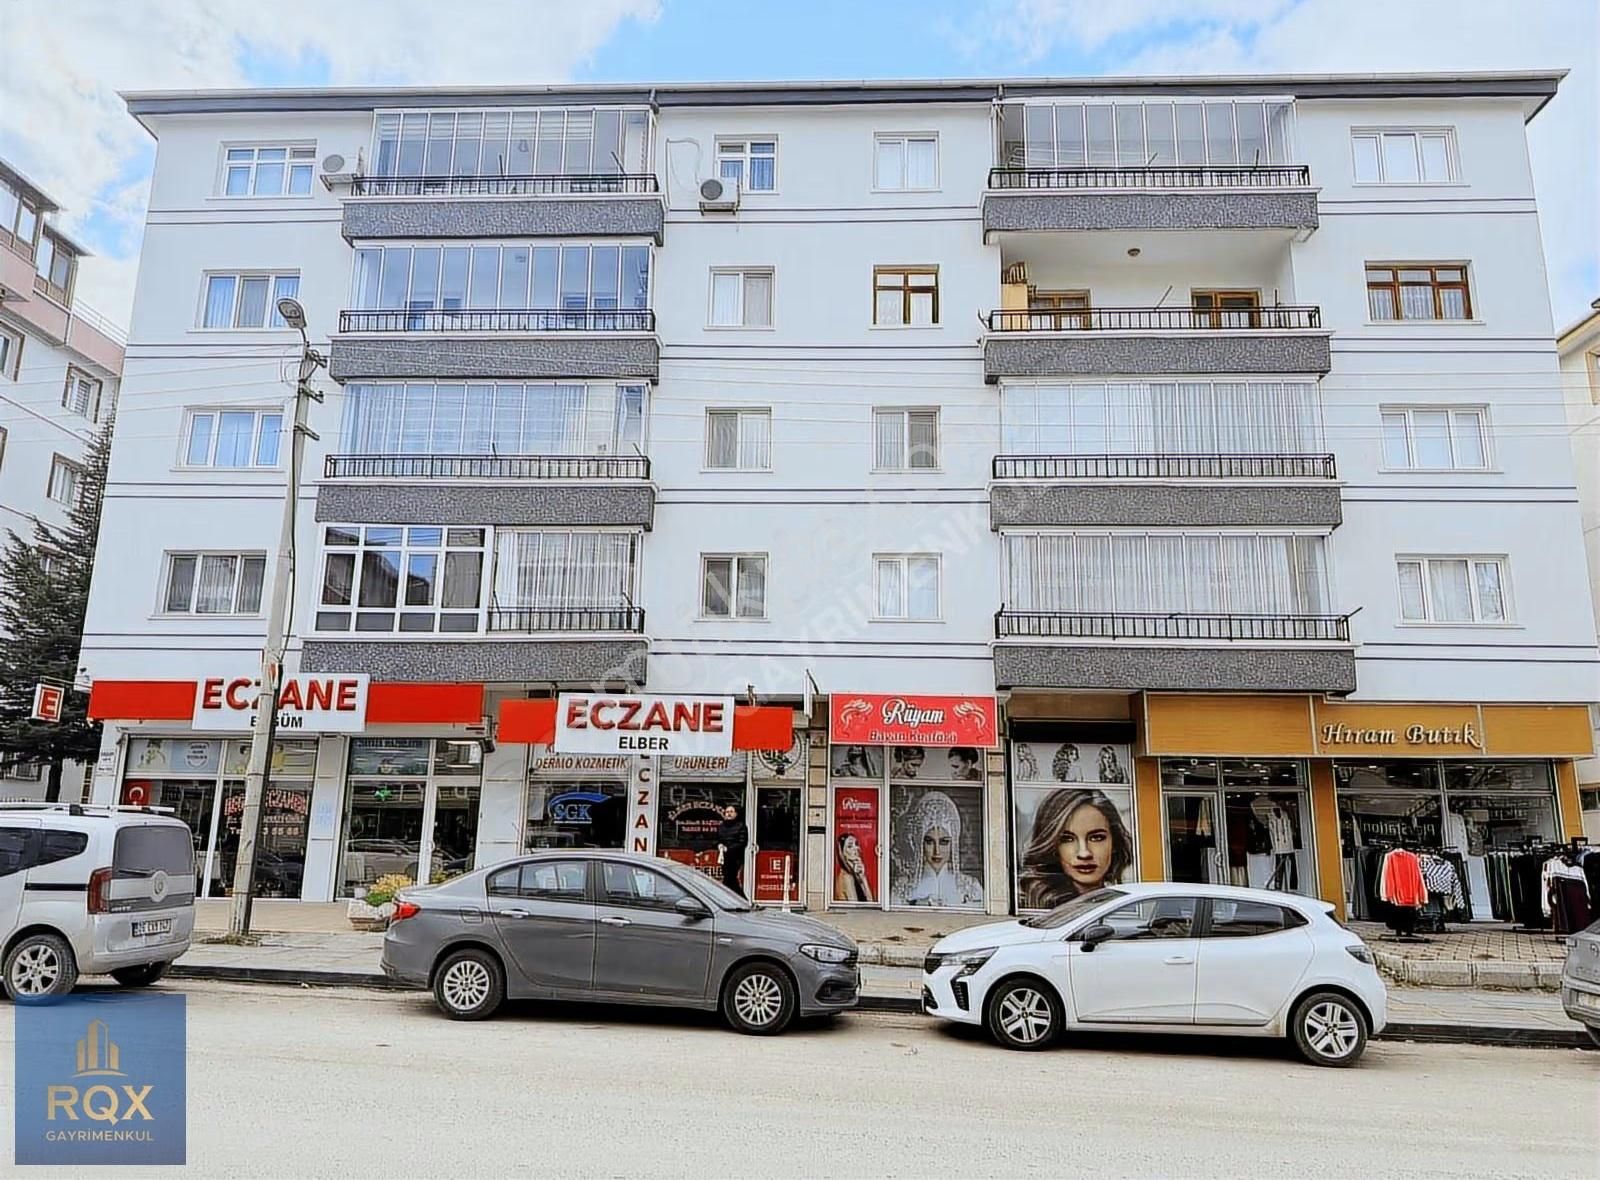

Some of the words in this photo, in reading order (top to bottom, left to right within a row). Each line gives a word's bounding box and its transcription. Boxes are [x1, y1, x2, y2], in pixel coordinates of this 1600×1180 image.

[202, 678, 358, 711] ECANE
[250, 712, 303, 728] EÜM
[566, 698, 724, 733] ECZANE
[882, 696, 945, 729] Rüyam
[618, 736, 669, 751] ELBER
[553, 804, 592, 821] SGK
[773, 859, 781, 870] E
